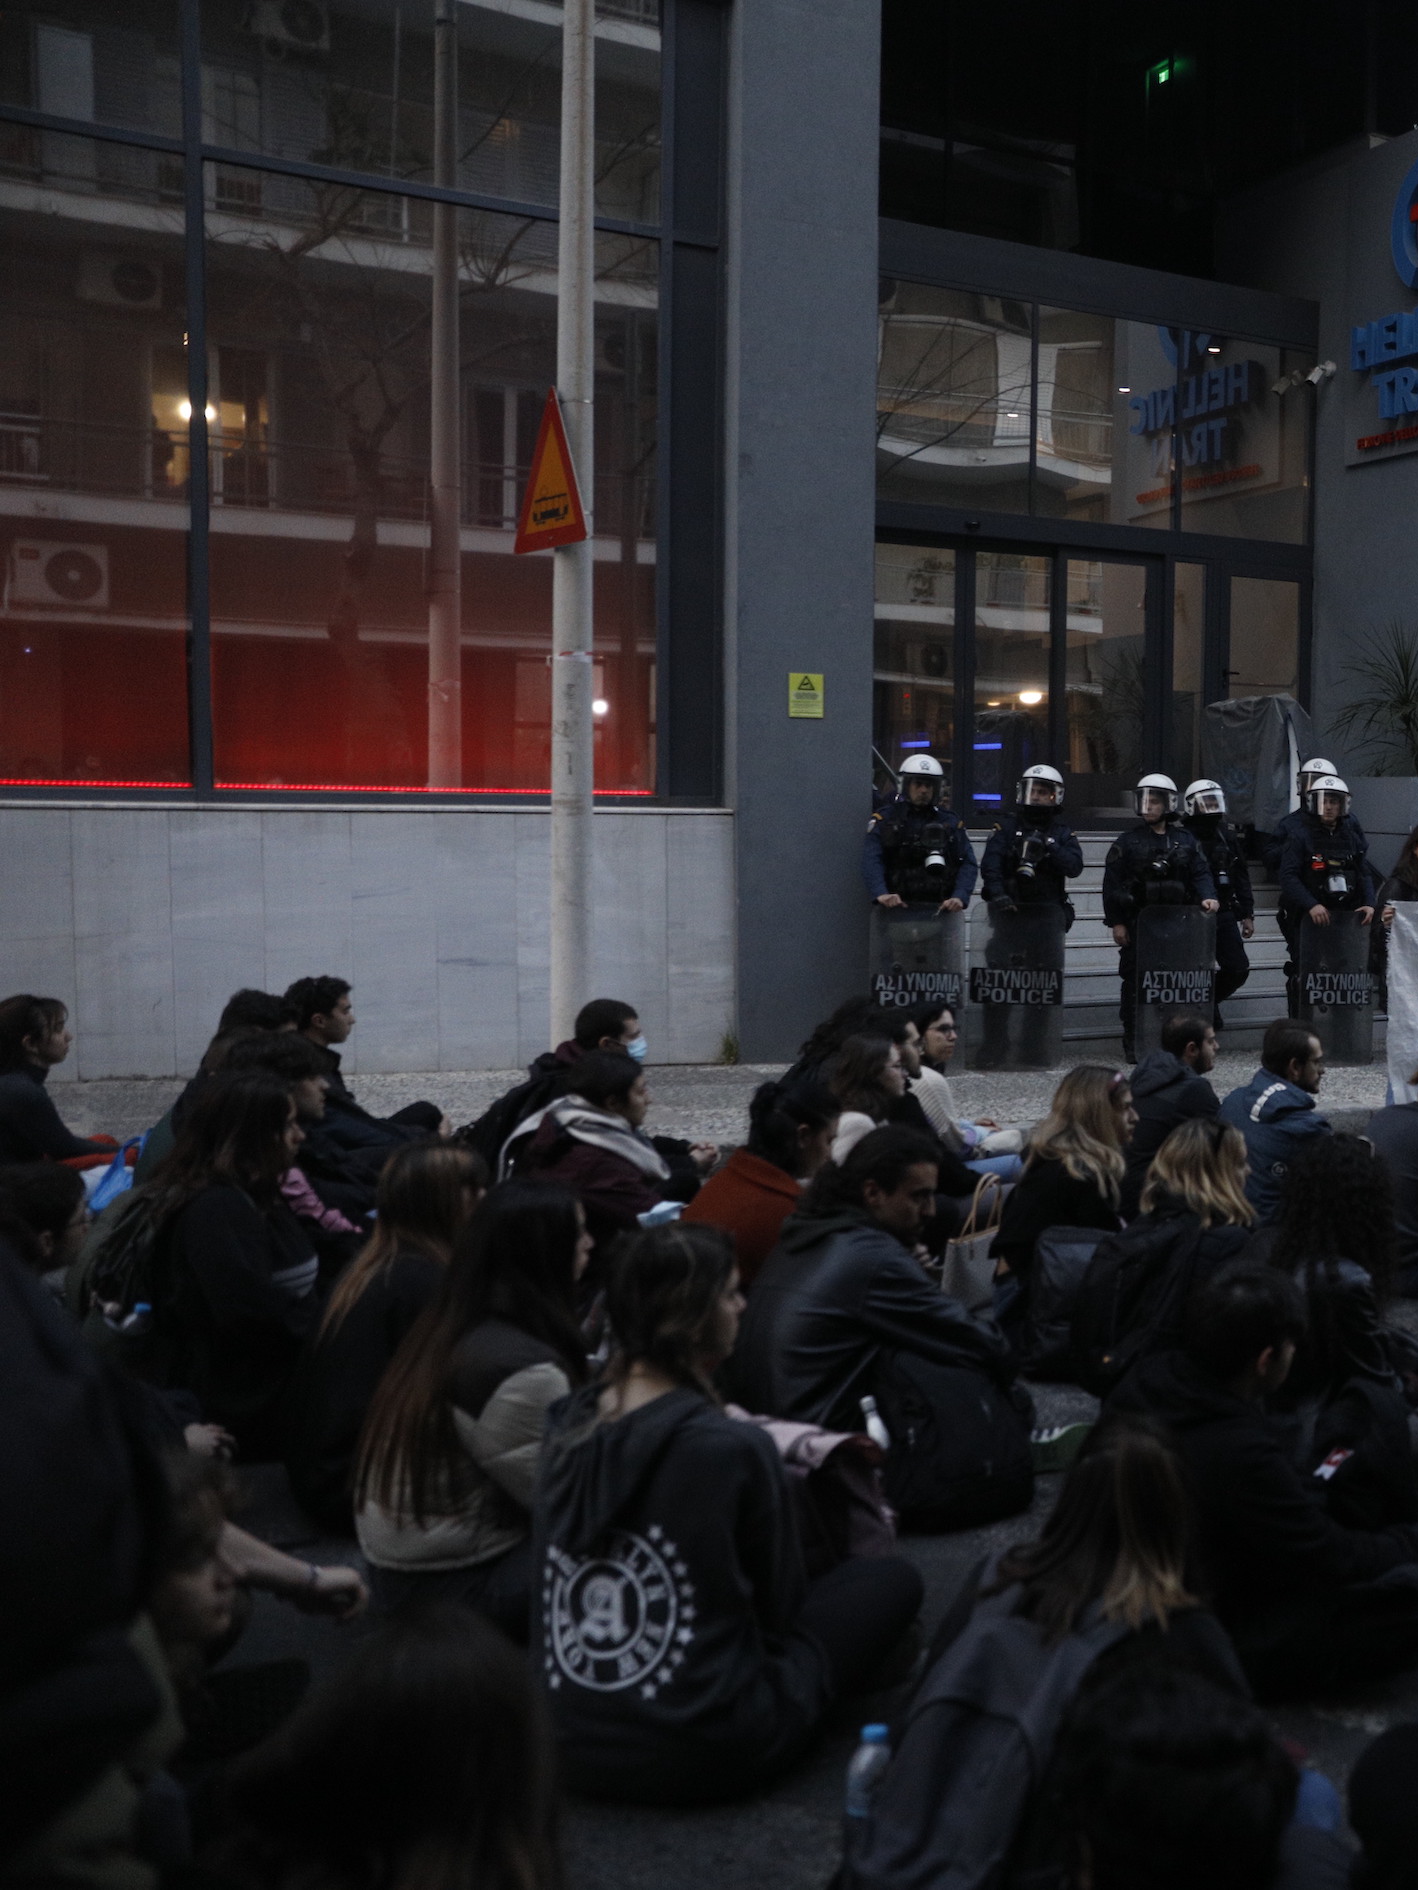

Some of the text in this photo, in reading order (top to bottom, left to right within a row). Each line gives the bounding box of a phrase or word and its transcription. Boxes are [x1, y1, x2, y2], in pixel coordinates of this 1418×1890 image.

[973, 969, 1059, 990] ΑΣΤΥΝΟΜΙΑ
[1142, 970, 1212, 989] ΑΣΤΥΝΟΜΙΑ
[977, 987, 1055, 1005] POLICE
[1146, 988, 1210, 1004] POLICE
[1309, 990, 1369, 1005] POLICE
